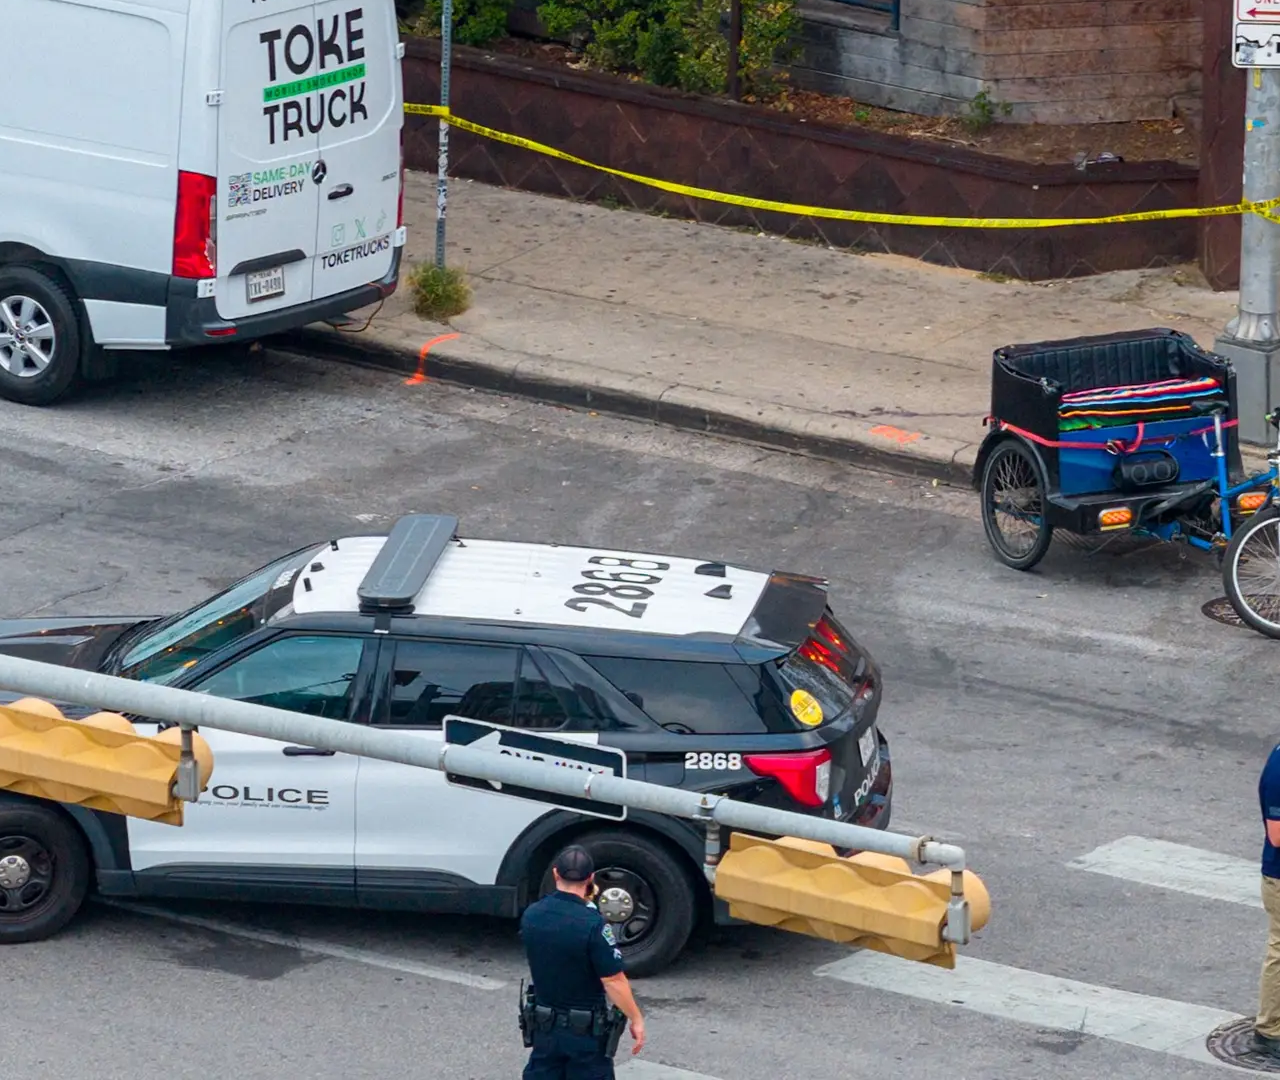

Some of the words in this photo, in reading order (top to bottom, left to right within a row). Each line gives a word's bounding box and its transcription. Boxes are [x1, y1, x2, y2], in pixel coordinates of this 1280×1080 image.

[259, 8, 365, 81] TOKE
[263, 82, 368, 144] TRUCK
[253, 161, 311, 185] SAME-DAY
[253, 179, 305, 201] DELIVERY
[321, 235, 391, 270] TOKETRUCKS
[564, 556, 670, 619] 2868
[685, 752, 742, 770] 2868
[206, 785, 329, 805] OLICE
